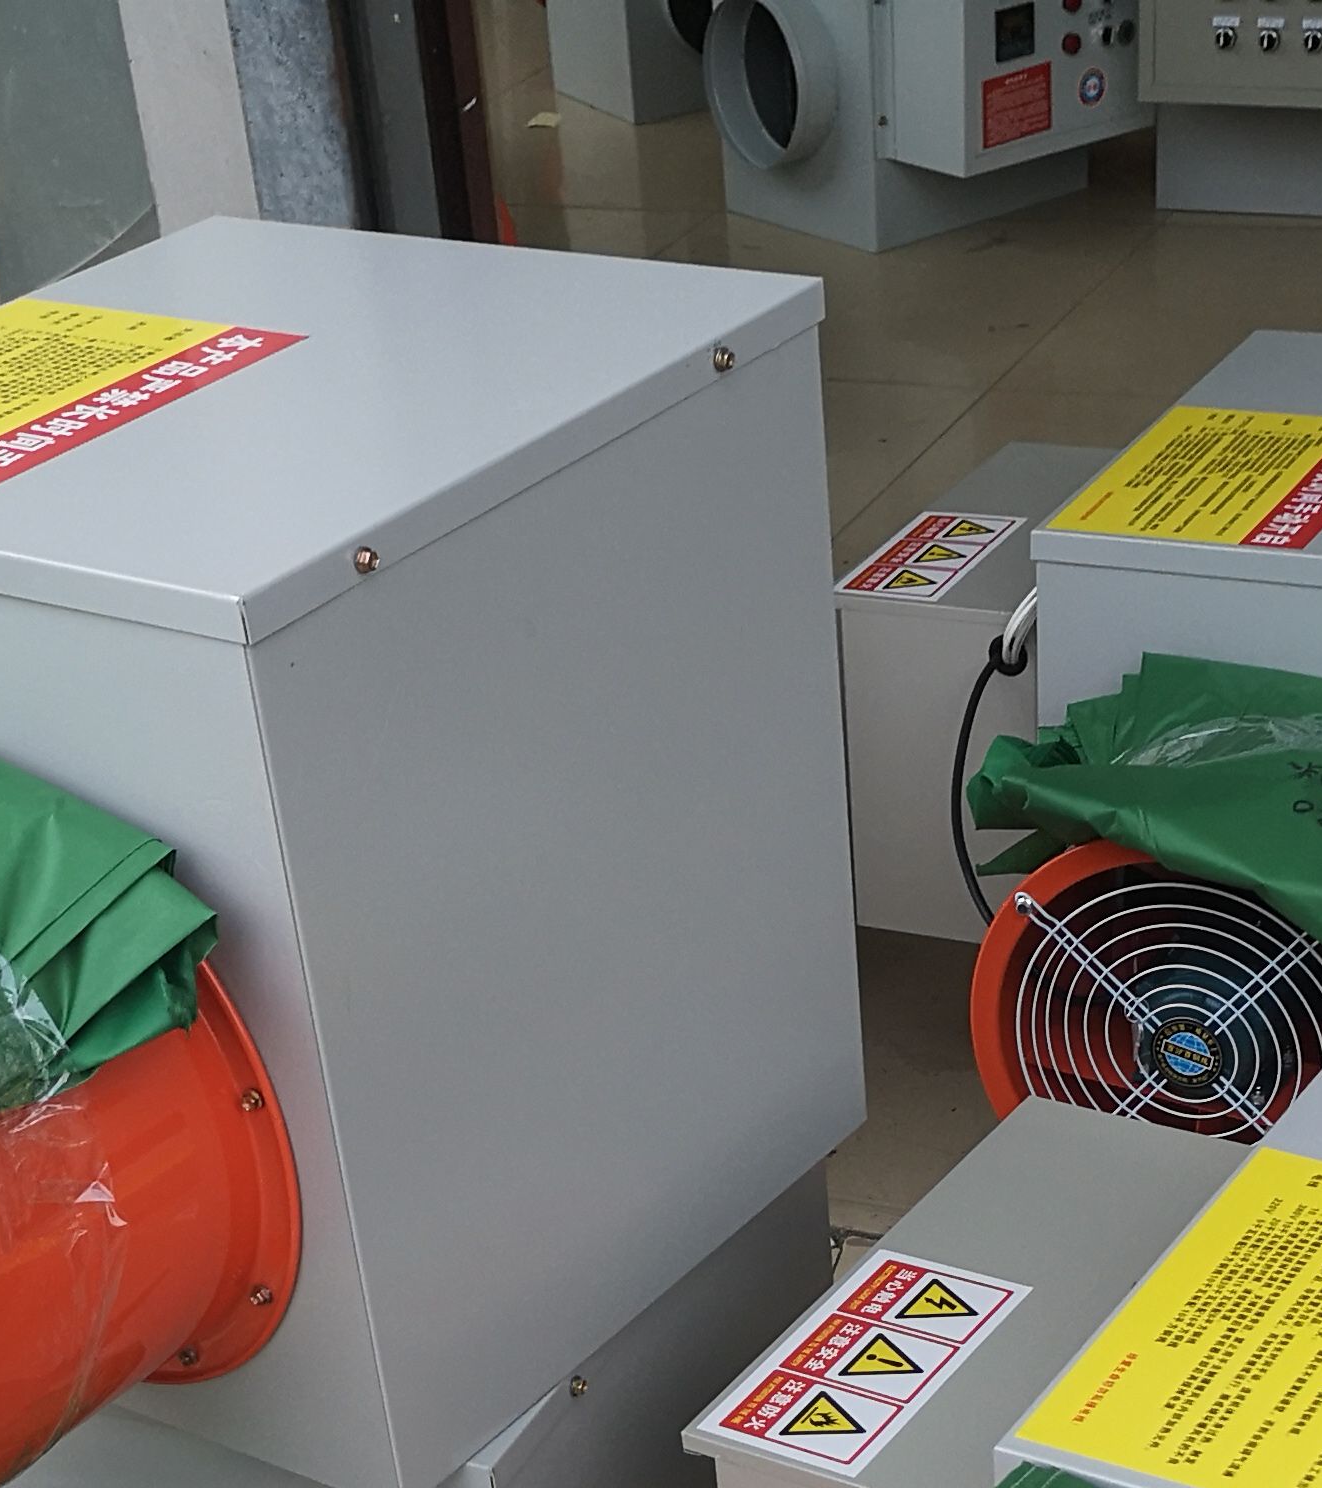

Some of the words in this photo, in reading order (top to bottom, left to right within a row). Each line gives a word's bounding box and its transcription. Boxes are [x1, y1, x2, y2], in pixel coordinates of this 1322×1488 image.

[860, 1268, 917, 1314] 当心触电
[802, 1322, 863, 1371] 注意安全
[743, 1379, 806, 1430] 注意防火
